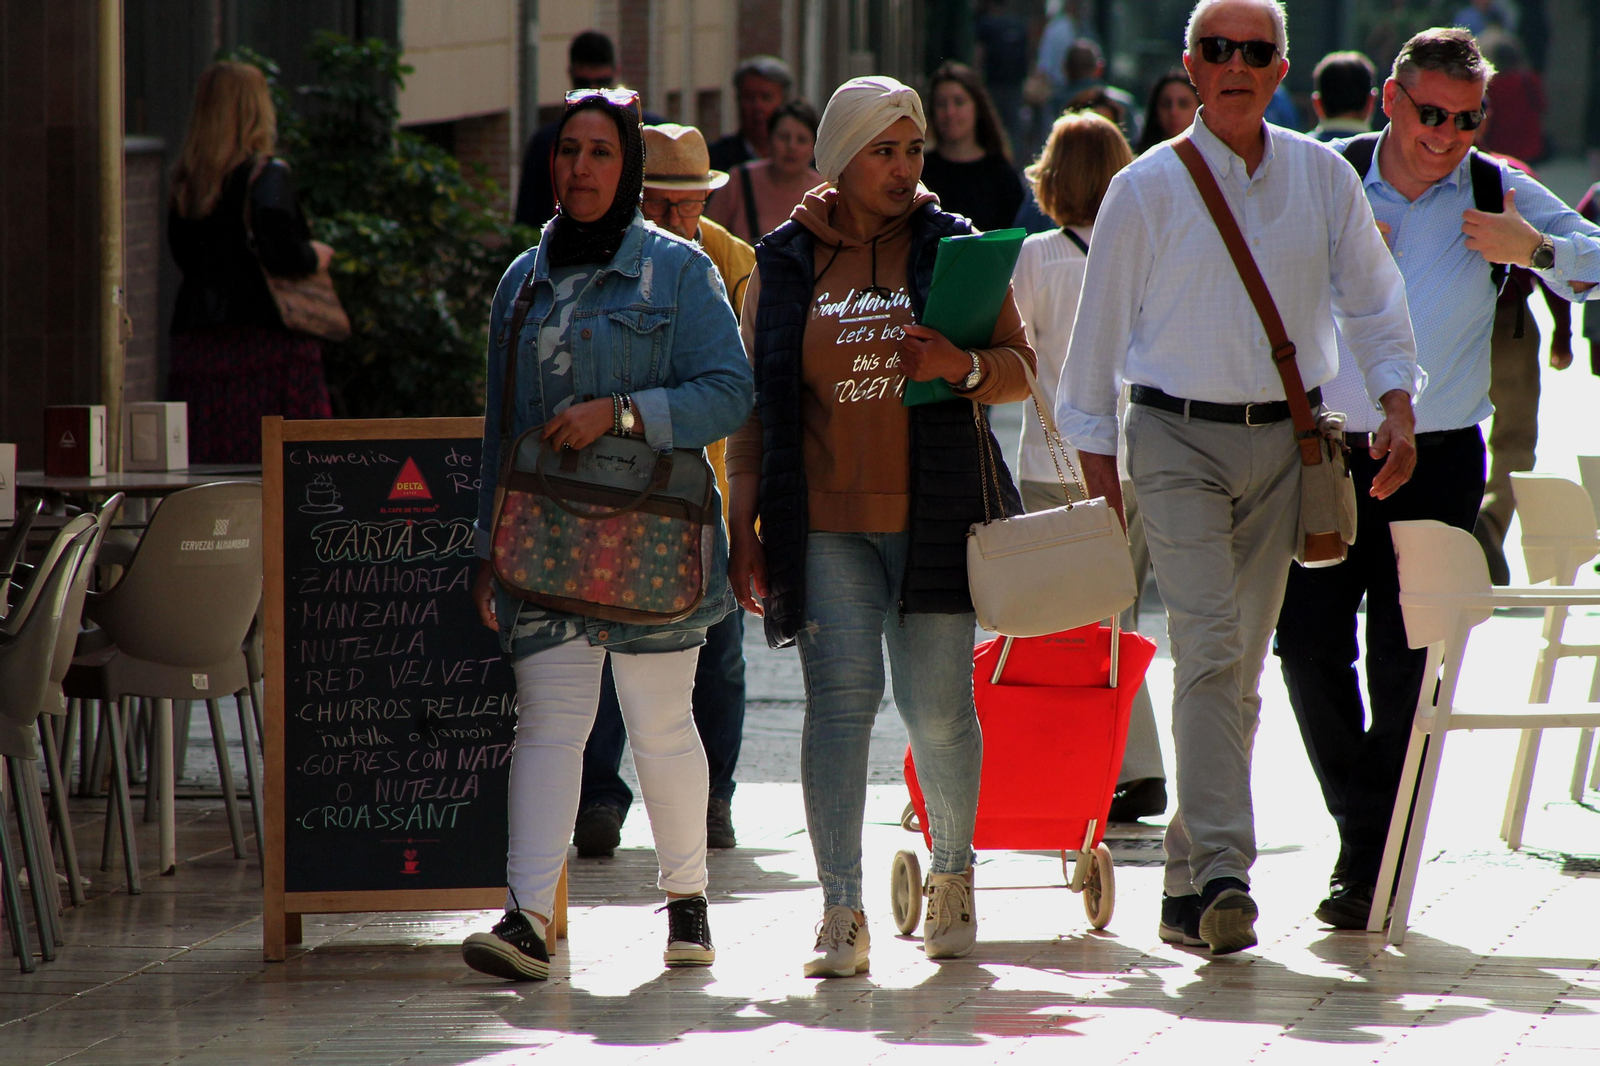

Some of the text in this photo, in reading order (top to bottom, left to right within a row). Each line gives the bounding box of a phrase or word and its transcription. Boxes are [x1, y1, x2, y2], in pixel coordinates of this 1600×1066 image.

[812, 287, 915, 320] Good Mornin
[836, 323, 906, 345] Let's beg
[852, 351, 901, 372] this da
[832, 375, 907, 403] TOGETH
[445, 447, 473, 467] de
[397, 482, 424, 490] DELTA
[446, 472, 482, 494] Ro
[181, 538, 250, 551] CERVEZAS ALHAMBRA
[320, 523, 438, 559] TARTAS
[299, 565, 469, 594] ZANAHORIA
[301, 599, 439, 629] MANZANA
[301, 630, 425, 663] NUTELLA
[306, 657, 501, 695] RED VELVET
[300, 692, 518, 723] CHURROS RELLEN
[408, 732, 421, 742] o
[303, 750, 400, 776] GOFRES
[406, 748, 447, 773] CON
[336, 774, 479, 804] O NUTELLA
[302, 801, 471, 831] CROASSANT
